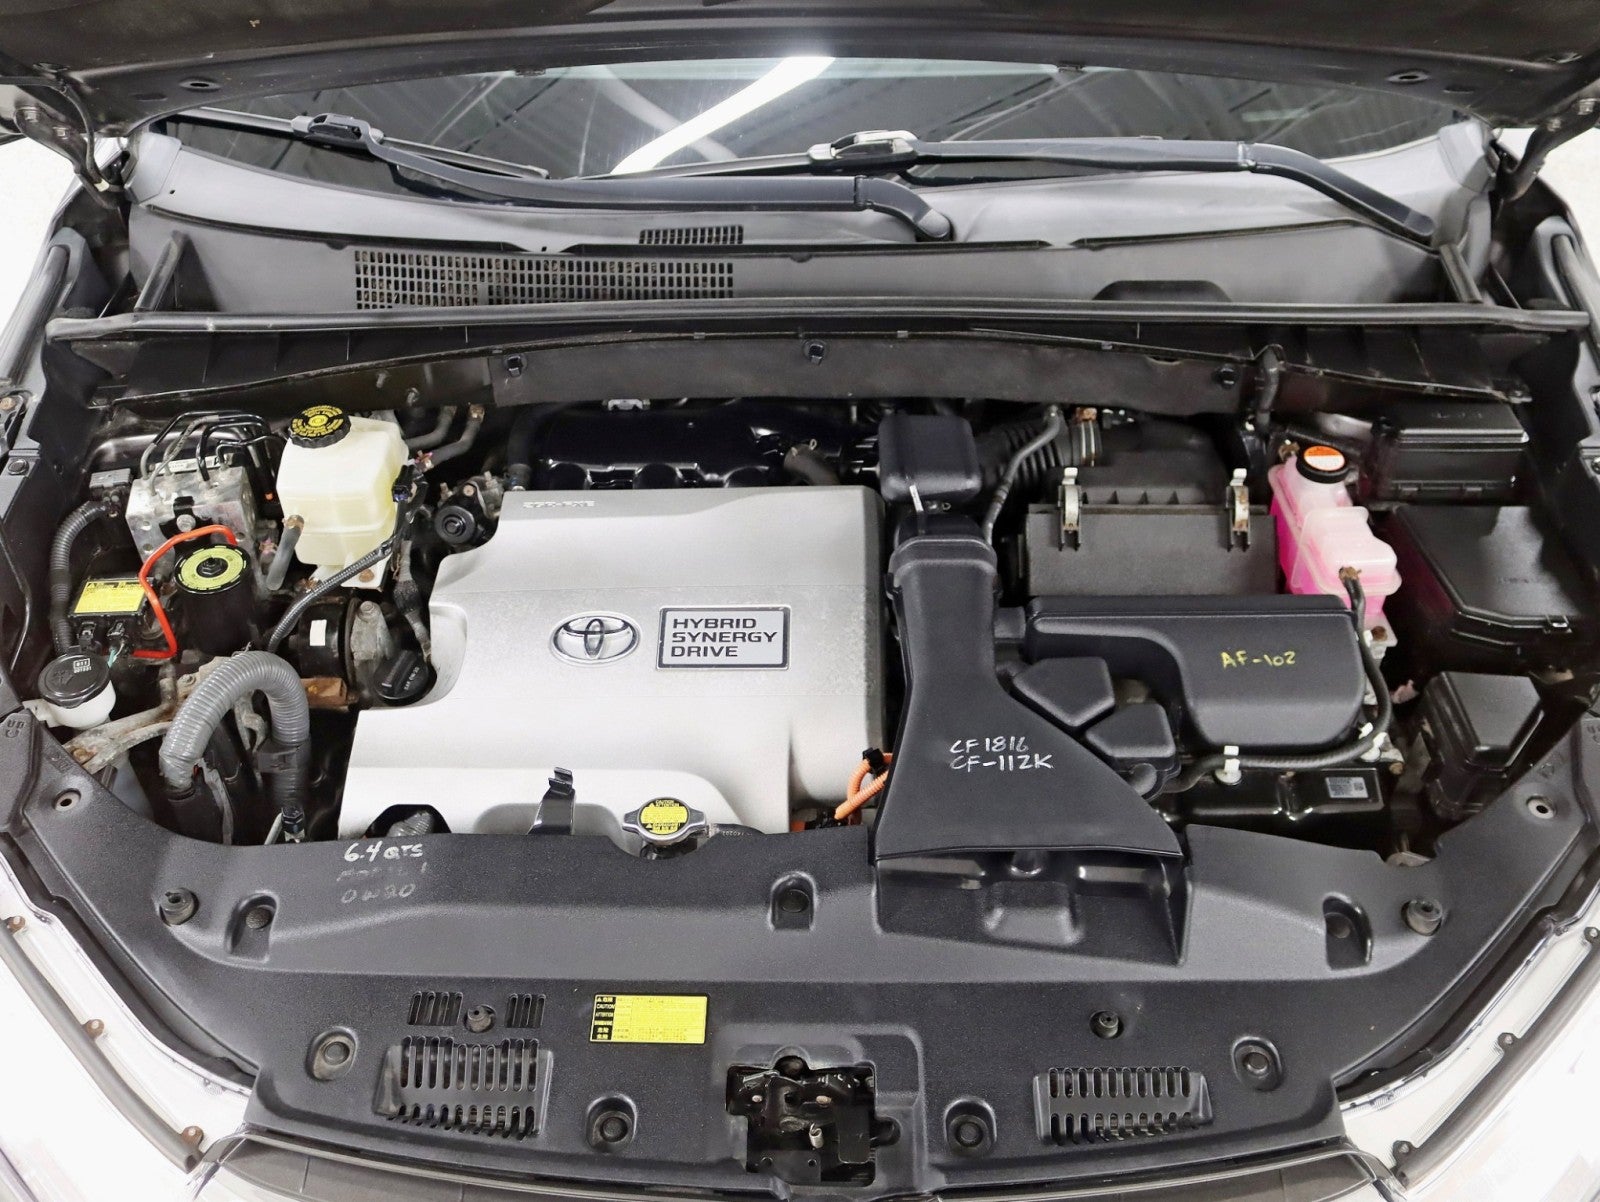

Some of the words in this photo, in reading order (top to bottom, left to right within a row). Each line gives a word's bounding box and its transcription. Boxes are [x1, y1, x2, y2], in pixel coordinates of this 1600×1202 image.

[673, 618, 756, 629] HYBRID
[672, 631, 778, 643] SYNERGY
[671, 646, 738, 657] DRIVE
[1221, 650, 1296, 669] AF-102
[344, 840, 383, 862] 6.4
